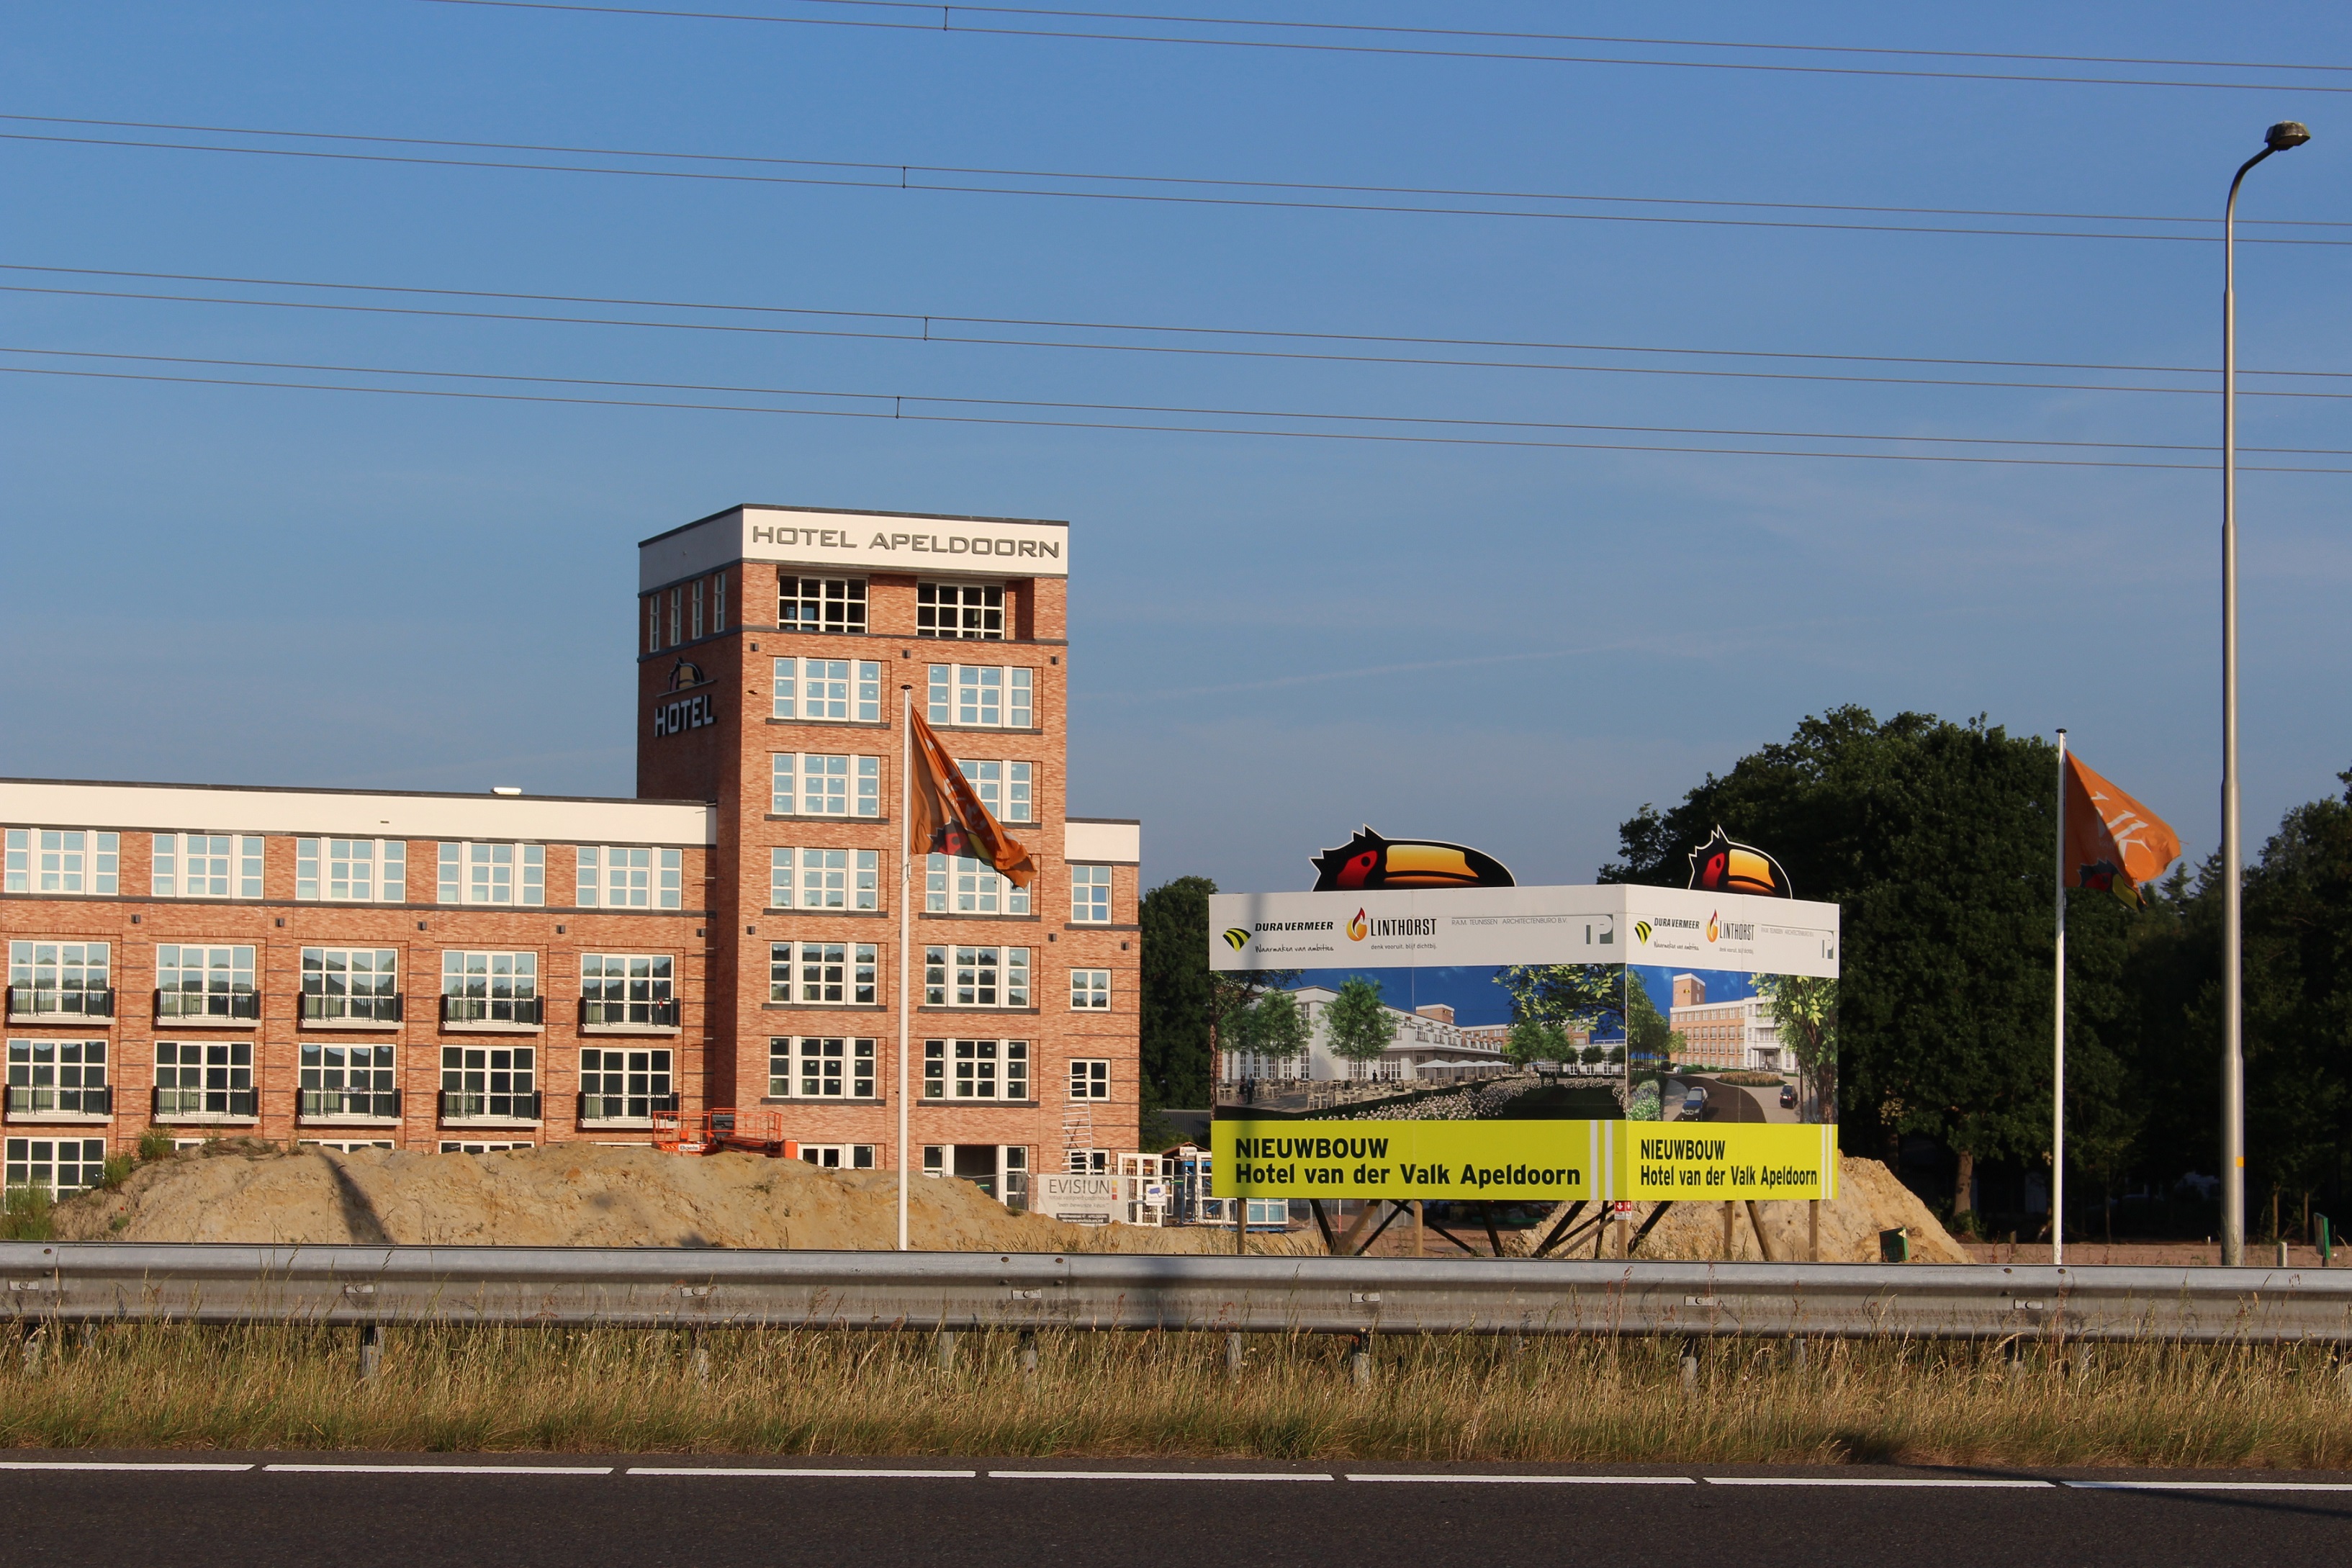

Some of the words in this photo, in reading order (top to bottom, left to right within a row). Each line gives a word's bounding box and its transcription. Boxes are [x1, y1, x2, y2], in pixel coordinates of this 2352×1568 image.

[752, 526, 857, 549] HOTEL
[868, 532, 1059, 558] APELDOORN
[654, 694, 715, 737] HOTEL
[1254, 922, 1283, 932] DURA
[1284, 921, 1333, 931] VERMEER
[1370, 918, 1437, 937] LINTHORST
[1654, 918, 1671, 927] DURA
[1671, 919, 1700, 929] VERMEER
[1720, 921, 1754, 941] LINTHORST
[1255, 944, 1294, 953] Waarmaken
[1307, 943, 1335, 952] ambities
[1235, 1137, 1389, 1158] NIEUWBOUW
[1641, 1139, 1726, 1161] NIEUWBOUW
[1235, 1163, 1294, 1184] Hotel
[1305, 1168, 1344, 1184] van
[1353, 1163, 1390, 1184] der
[1400, 1163, 1451, 1184] Valk
[1460, 1163, 1581, 1189] Apeldoorn
[1641, 1165, 1675, 1186] Hotel
[1680, 1170, 1700, 1186] van
[1706, 1165, 1726, 1186] der
[1731, 1165, 1756, 1186] Valk
[1760, 1165, 1817, 1189] Apeldoorn
[1049, 1179, 1109, 1194] EVISIUN
